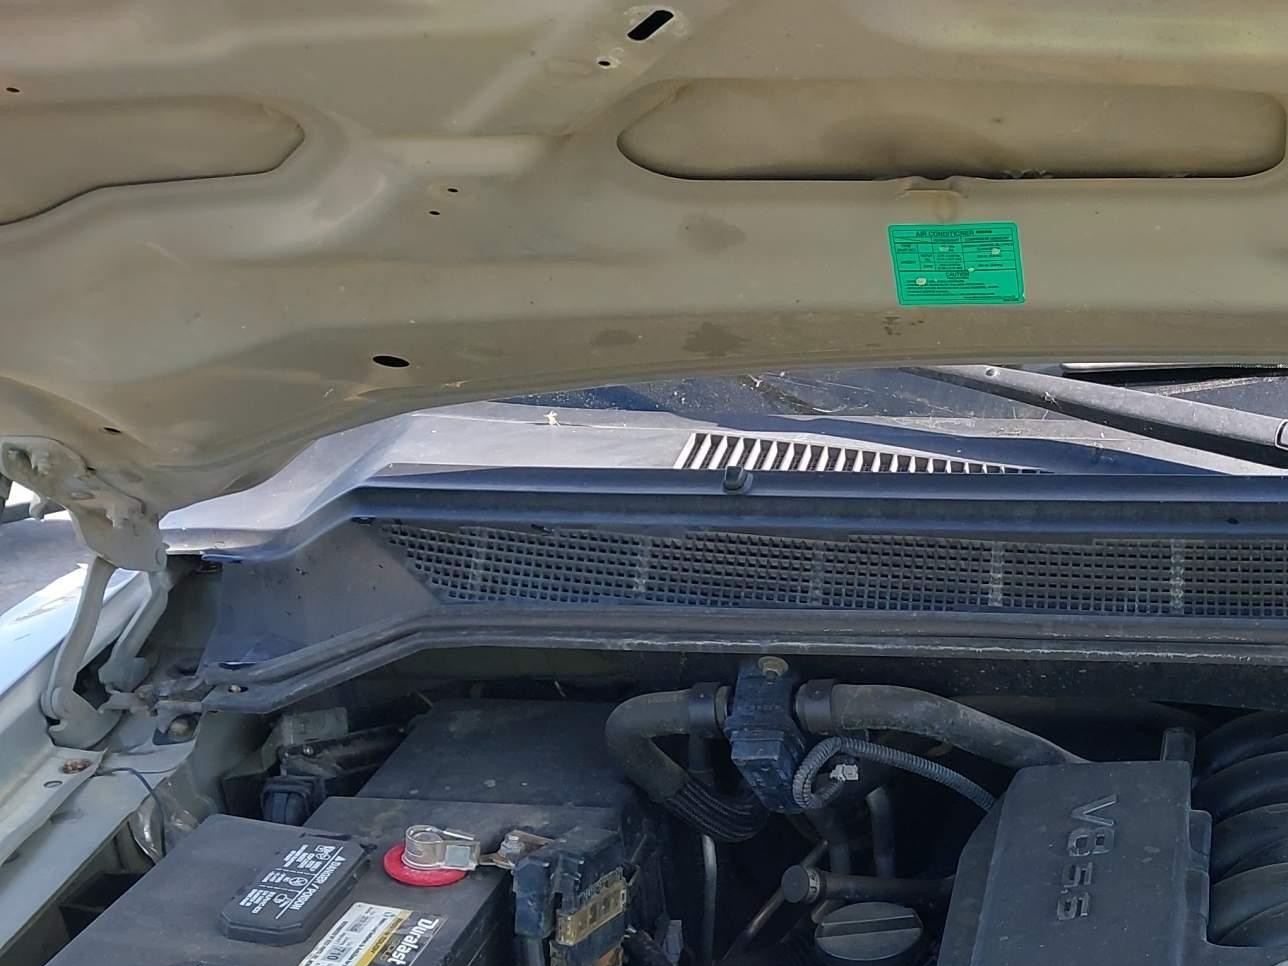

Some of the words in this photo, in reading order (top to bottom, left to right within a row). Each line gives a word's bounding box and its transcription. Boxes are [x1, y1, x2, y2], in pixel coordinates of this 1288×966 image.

[1067, 791, 1118, 857] V8
[325, 946, 347, 961] 710
[387, 917, 440, 966] Duralast
